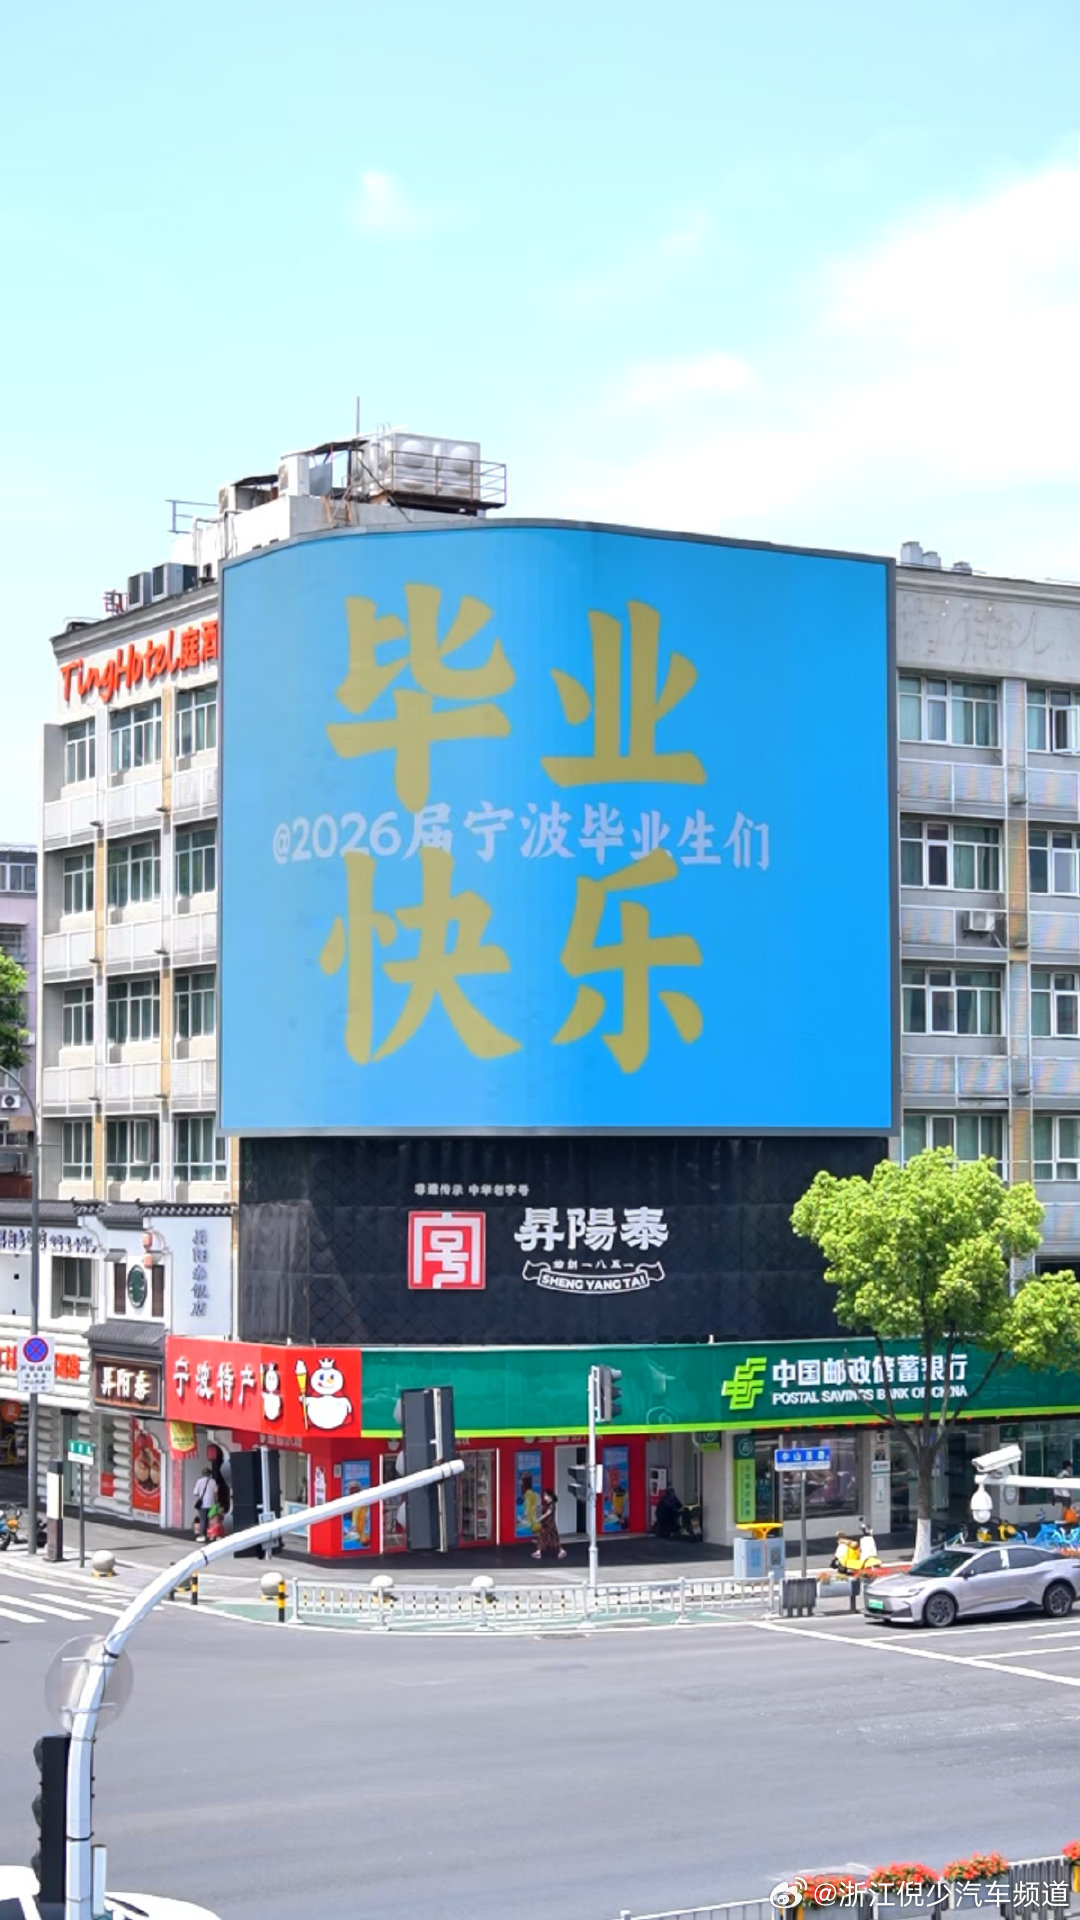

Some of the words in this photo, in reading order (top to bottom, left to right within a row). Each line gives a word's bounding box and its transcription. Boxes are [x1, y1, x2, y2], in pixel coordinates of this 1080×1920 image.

[326, 582, 708, 813] 毕业
[272, 799, 771, 873] @2026届宁波毕业生们
[319, 846, 707, 1075] 快乐
[542, 1274, 584, 1290] SHENG
[586, 1278, 622, 1290] YANG
[622, 1276, 646, 1289] TAI
[172, 1356, 256, 1405] 宁波特产
[773, 1352, 968, 1388] 中国邮政储蓄银行
[773, 1391, 819, 1405] POSTAL
